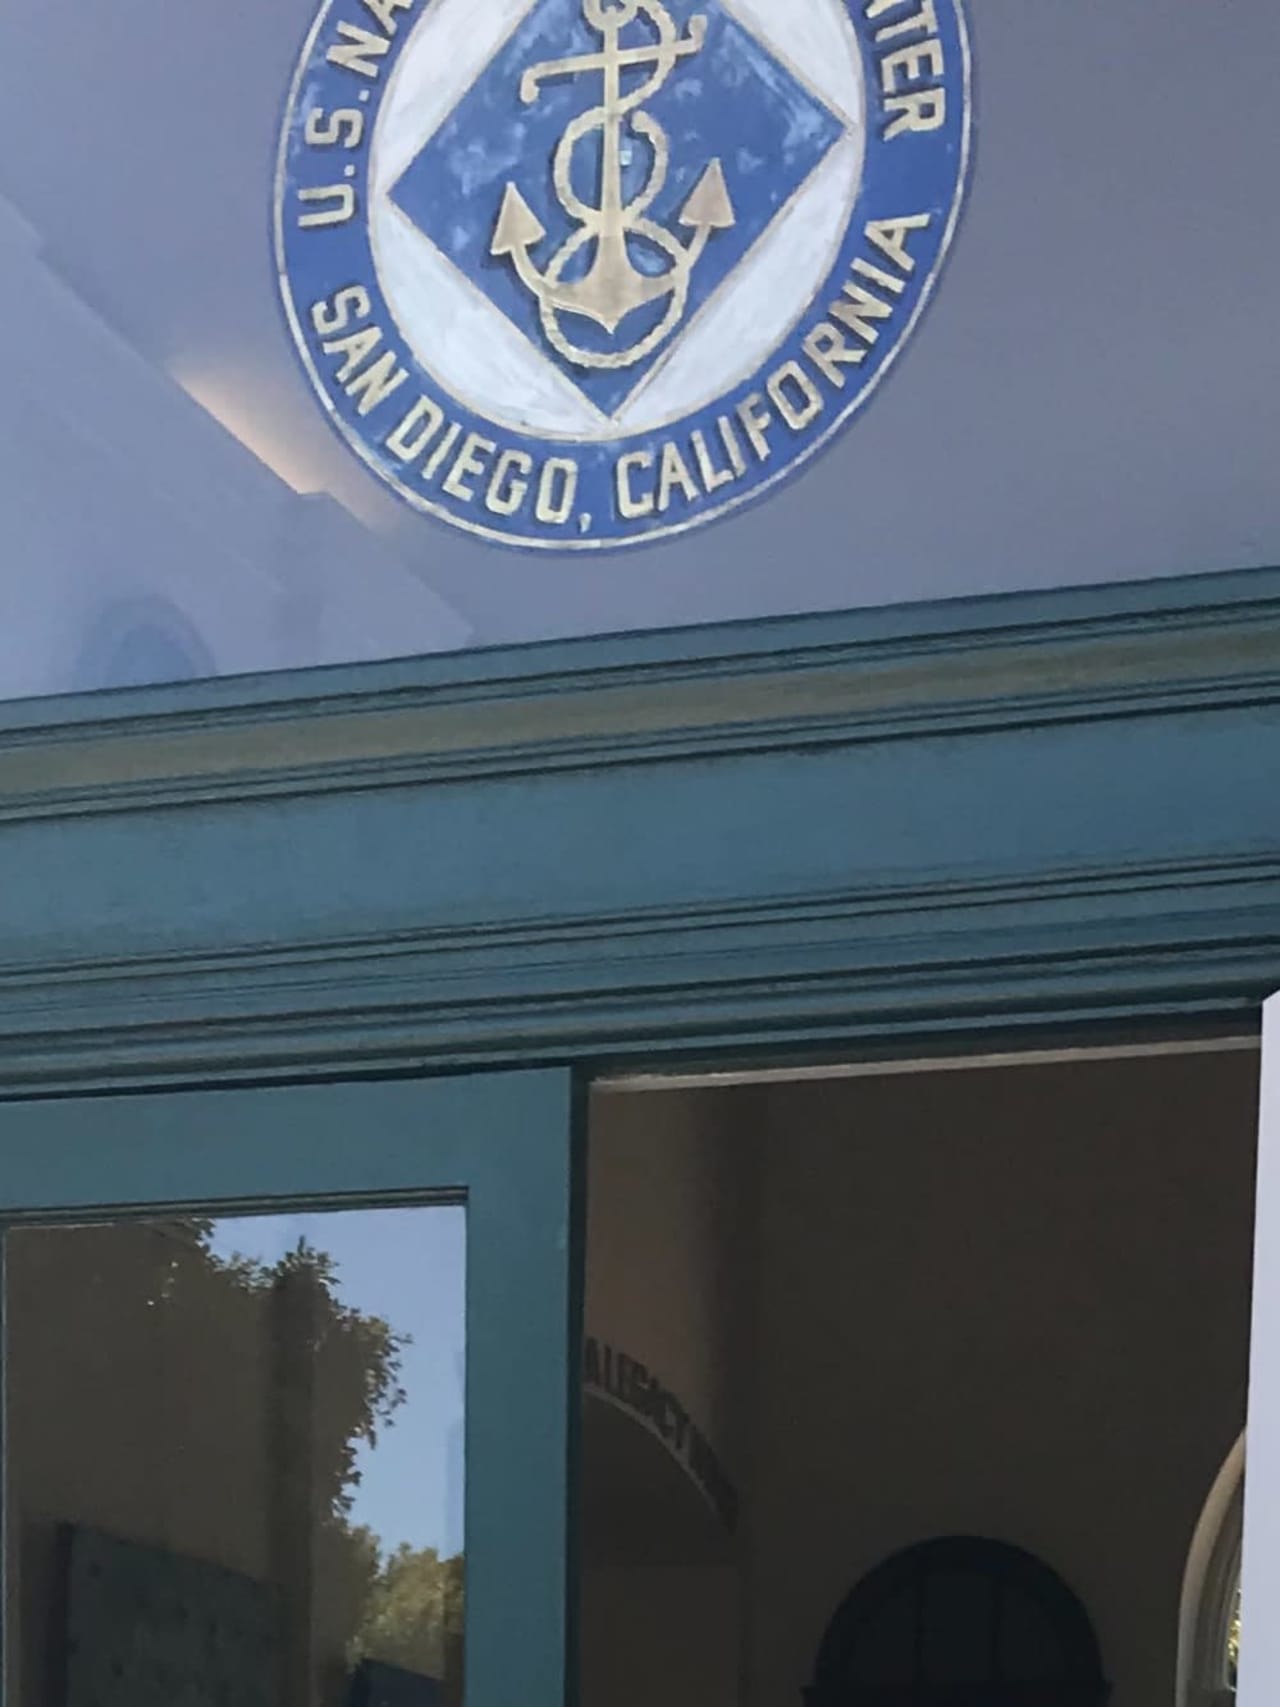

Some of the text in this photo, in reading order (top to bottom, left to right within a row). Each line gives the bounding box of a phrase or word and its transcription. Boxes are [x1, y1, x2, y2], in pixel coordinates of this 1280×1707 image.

[311, 213, 931, 533] SAN DIEGO, CALIFORNIA
